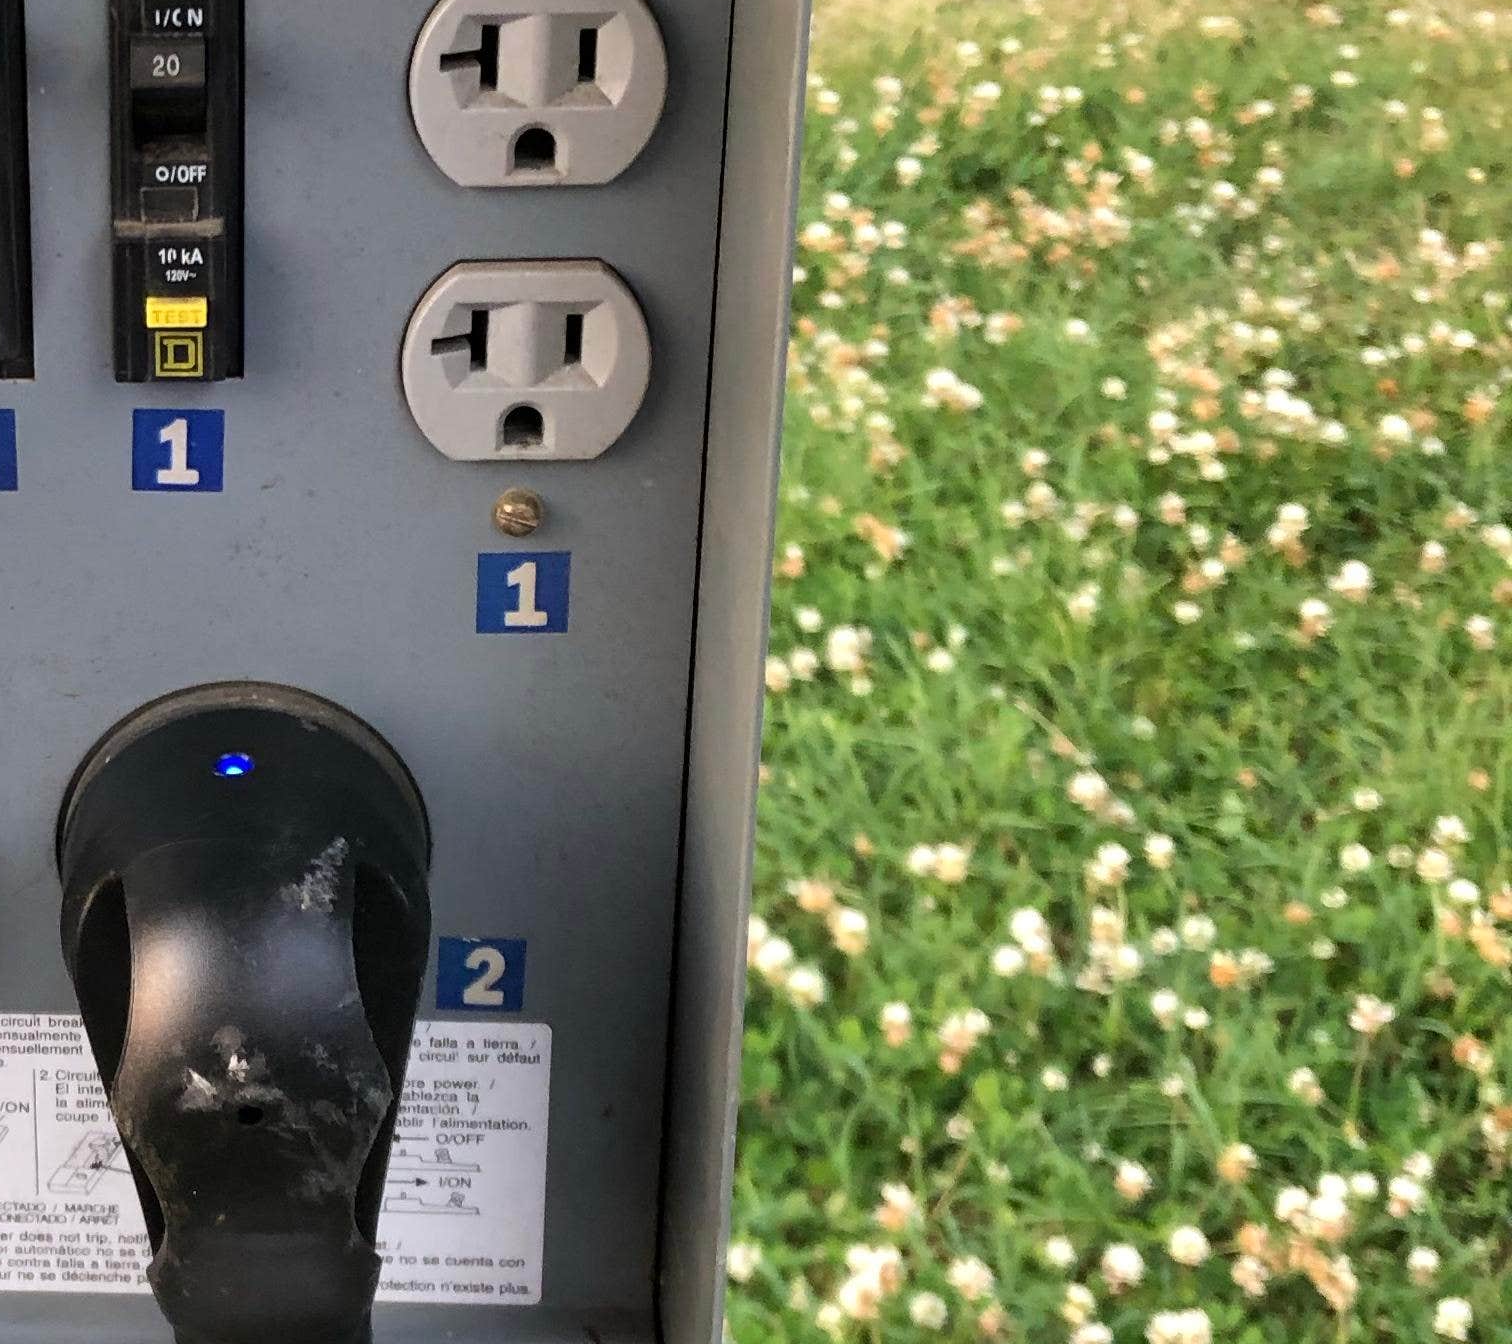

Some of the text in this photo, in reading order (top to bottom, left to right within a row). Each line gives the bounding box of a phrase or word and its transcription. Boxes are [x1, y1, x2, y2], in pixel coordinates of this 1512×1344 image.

[152, 53, 181, 78] 20
[155, 164, 208, 184] O/OFF
[181, 248, 204, 266] kA
[152, 309, 204, 325] TEST
[155, 417, 201, 485] 1
[502, 561, 549, 628] 1
[462, 946, 507, 1006] 2
[0, 1014, 40, 1028] circuit
